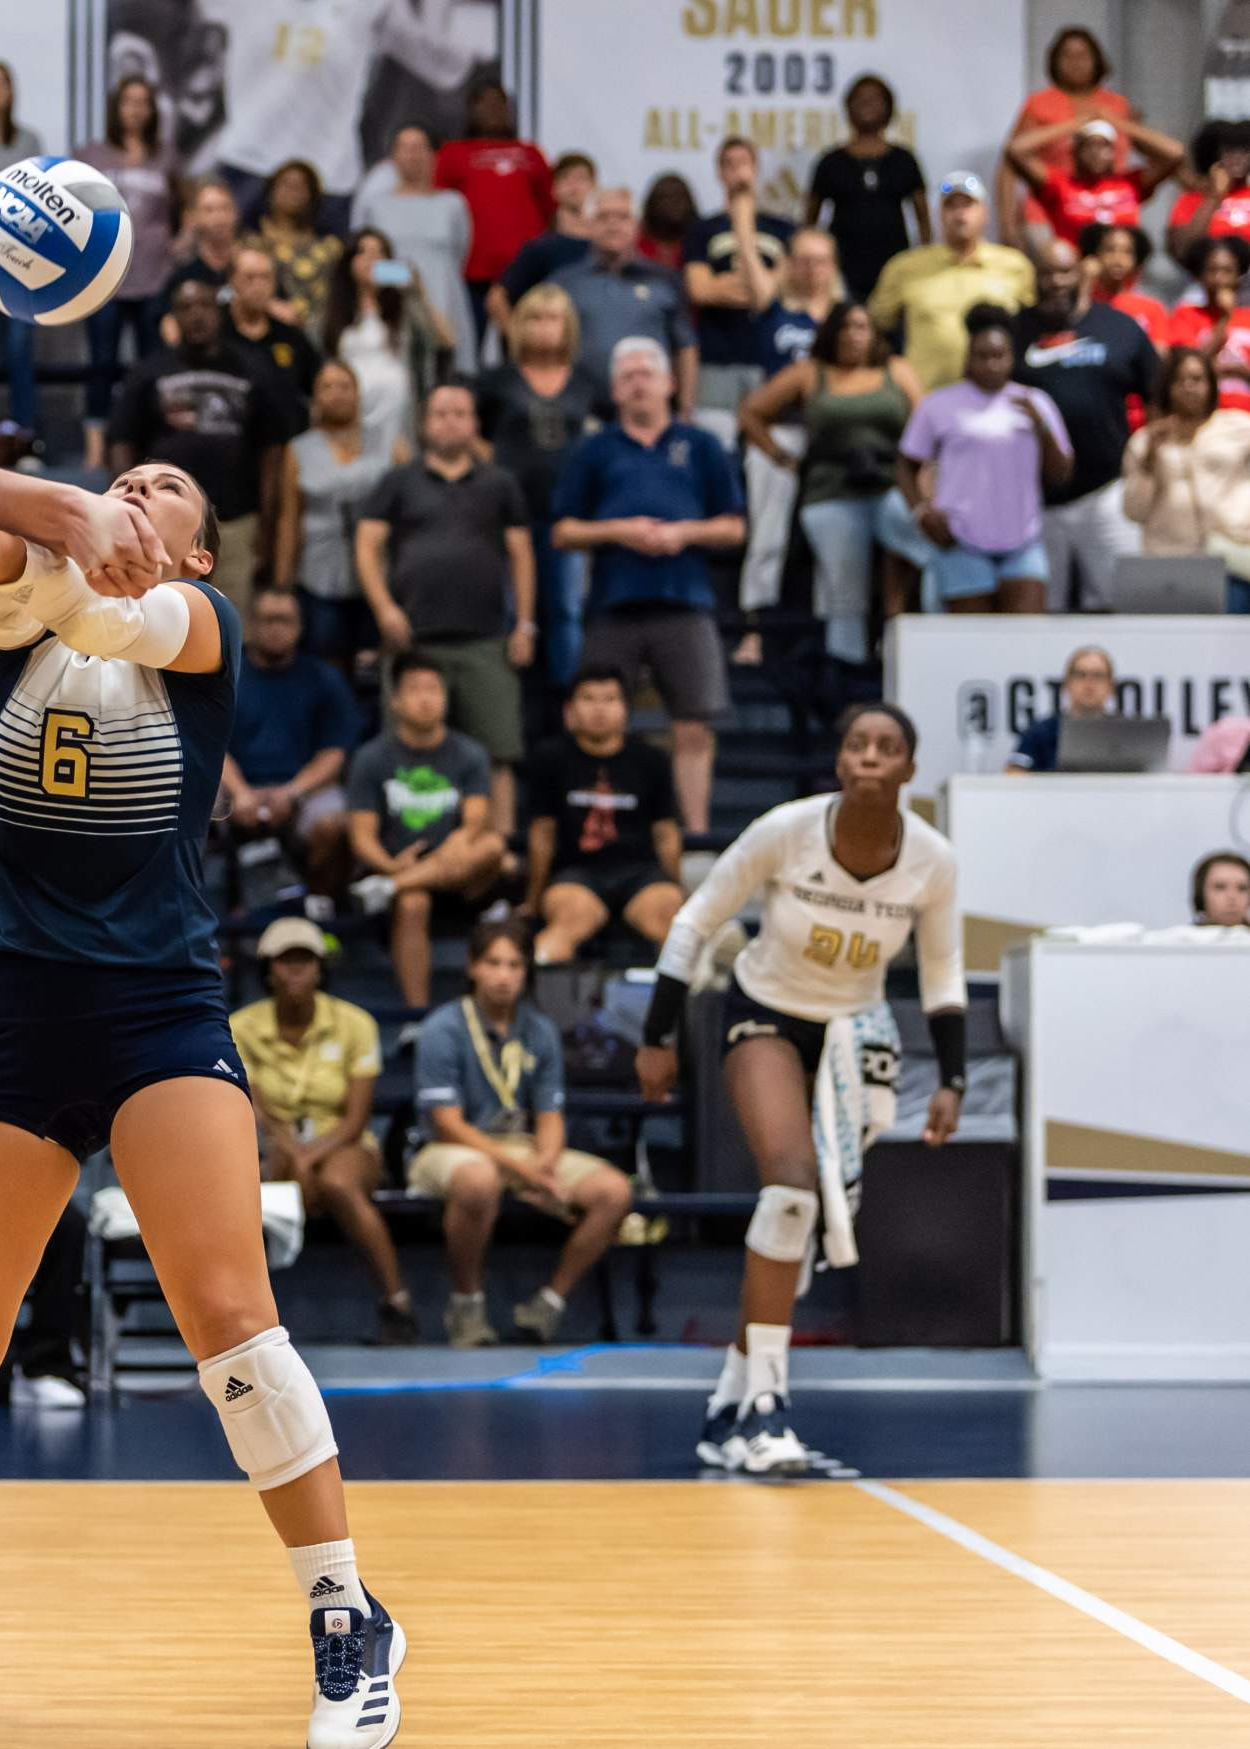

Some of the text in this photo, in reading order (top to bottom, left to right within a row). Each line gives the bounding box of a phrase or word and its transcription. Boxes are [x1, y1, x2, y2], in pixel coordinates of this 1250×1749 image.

[724, 51, 835, 95] 2003
[6, 168, 77, 227] molten
[39, 706, 94, 800] 6
[225, 1383, 254, 1402] adidas
[309, 1584, 345, 1599] adidas
